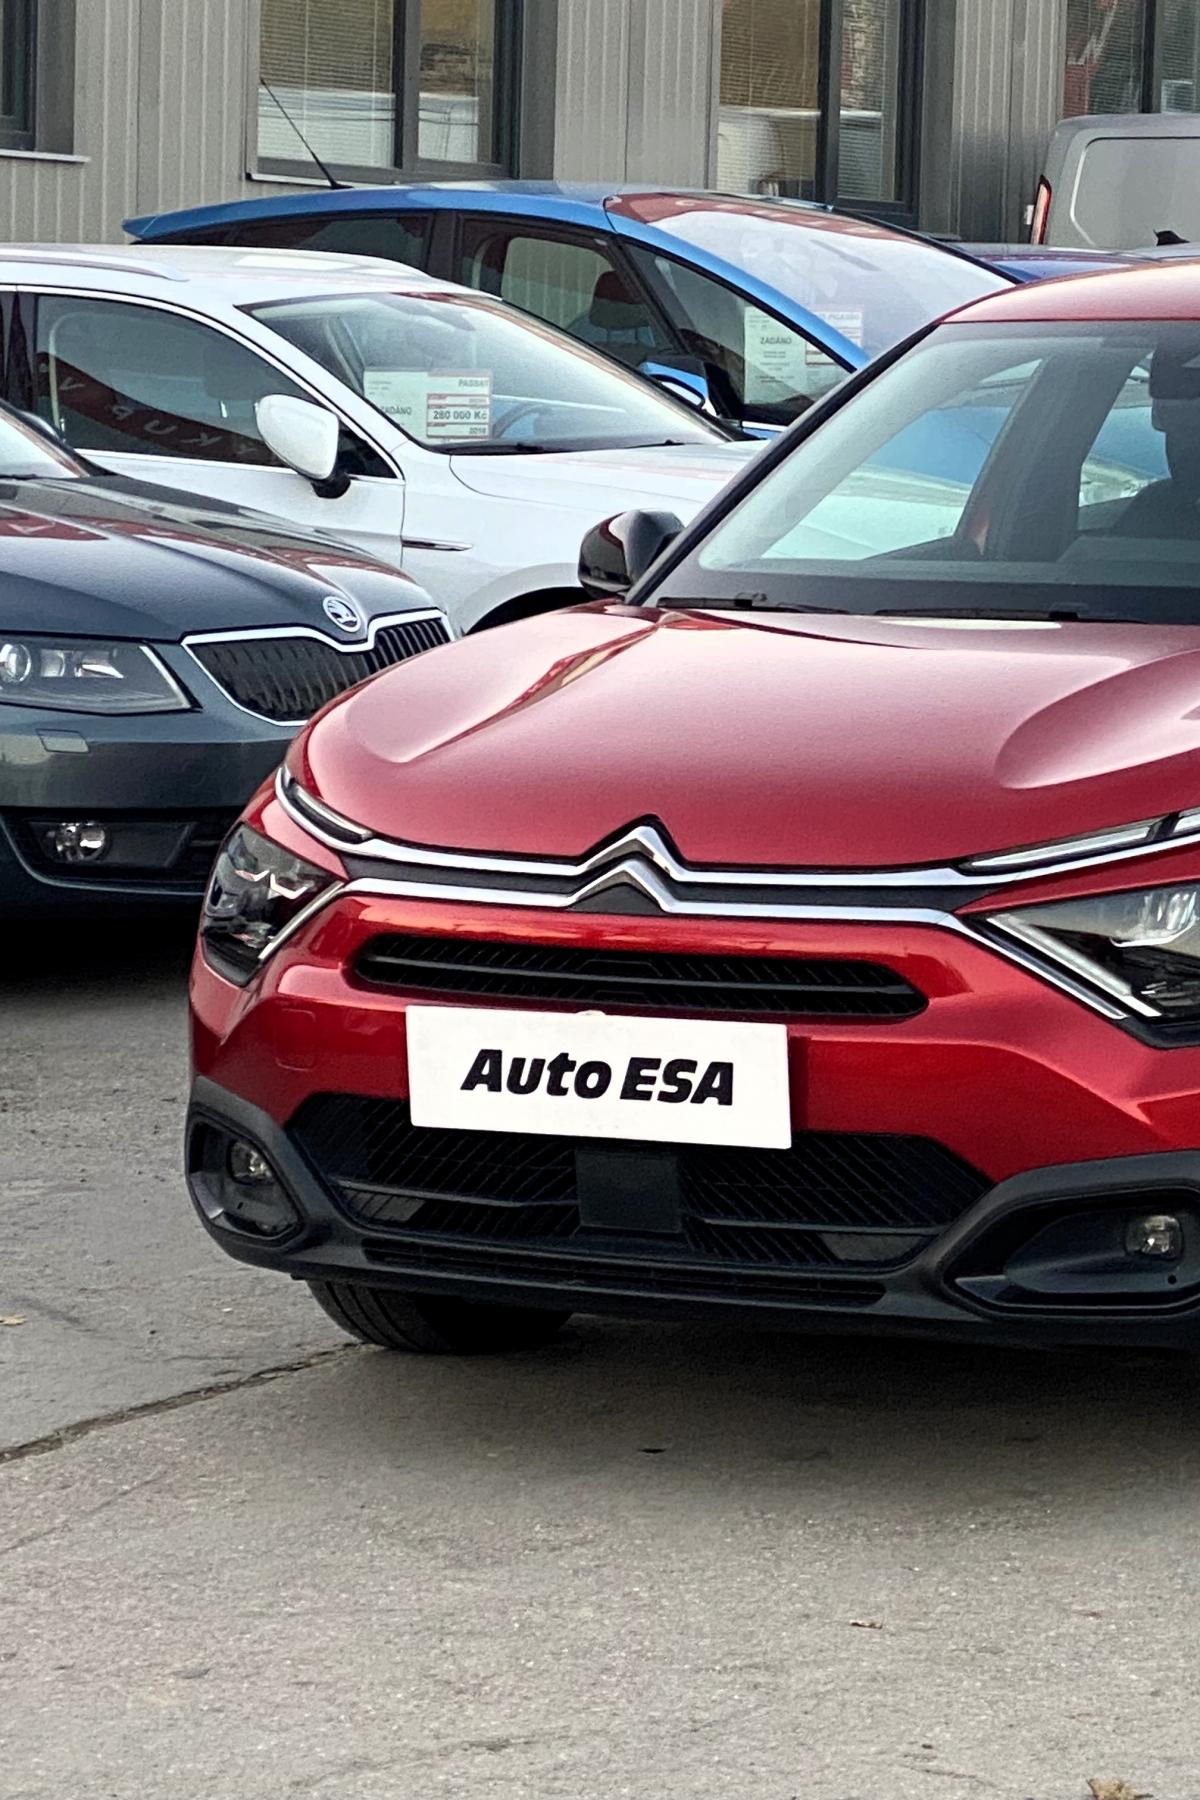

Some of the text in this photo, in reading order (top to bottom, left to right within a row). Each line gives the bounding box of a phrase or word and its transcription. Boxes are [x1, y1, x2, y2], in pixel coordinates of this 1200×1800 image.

[453, 410, 471, 420] 000
[460, 1048, 734, 1106] Auto ESA
